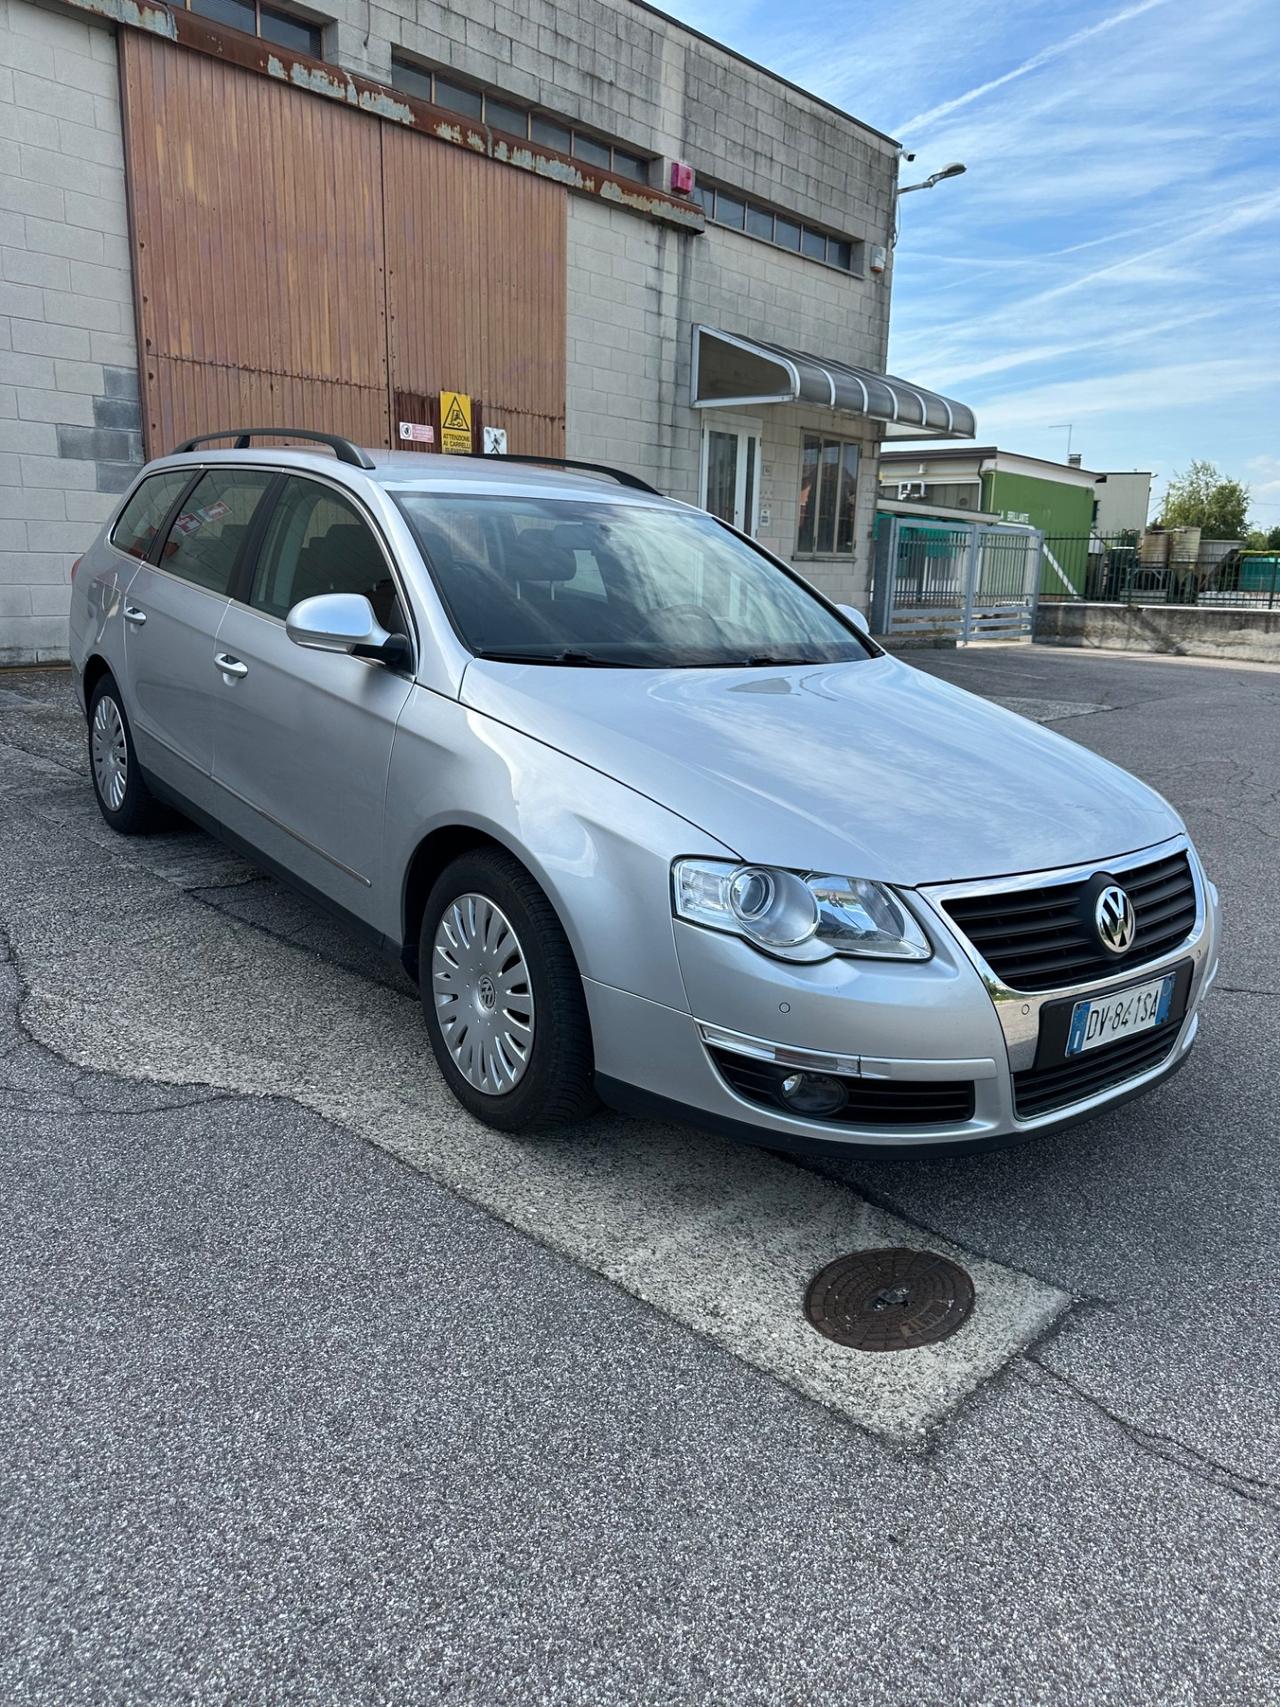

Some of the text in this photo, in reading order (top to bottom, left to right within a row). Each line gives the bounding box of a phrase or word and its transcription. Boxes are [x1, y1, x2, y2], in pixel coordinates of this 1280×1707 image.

[443, 433, 470, 442] ATTENZIONE
[449, 441, 470, 449] CARRELLI
[1096, 886, 1135, 953] VW
